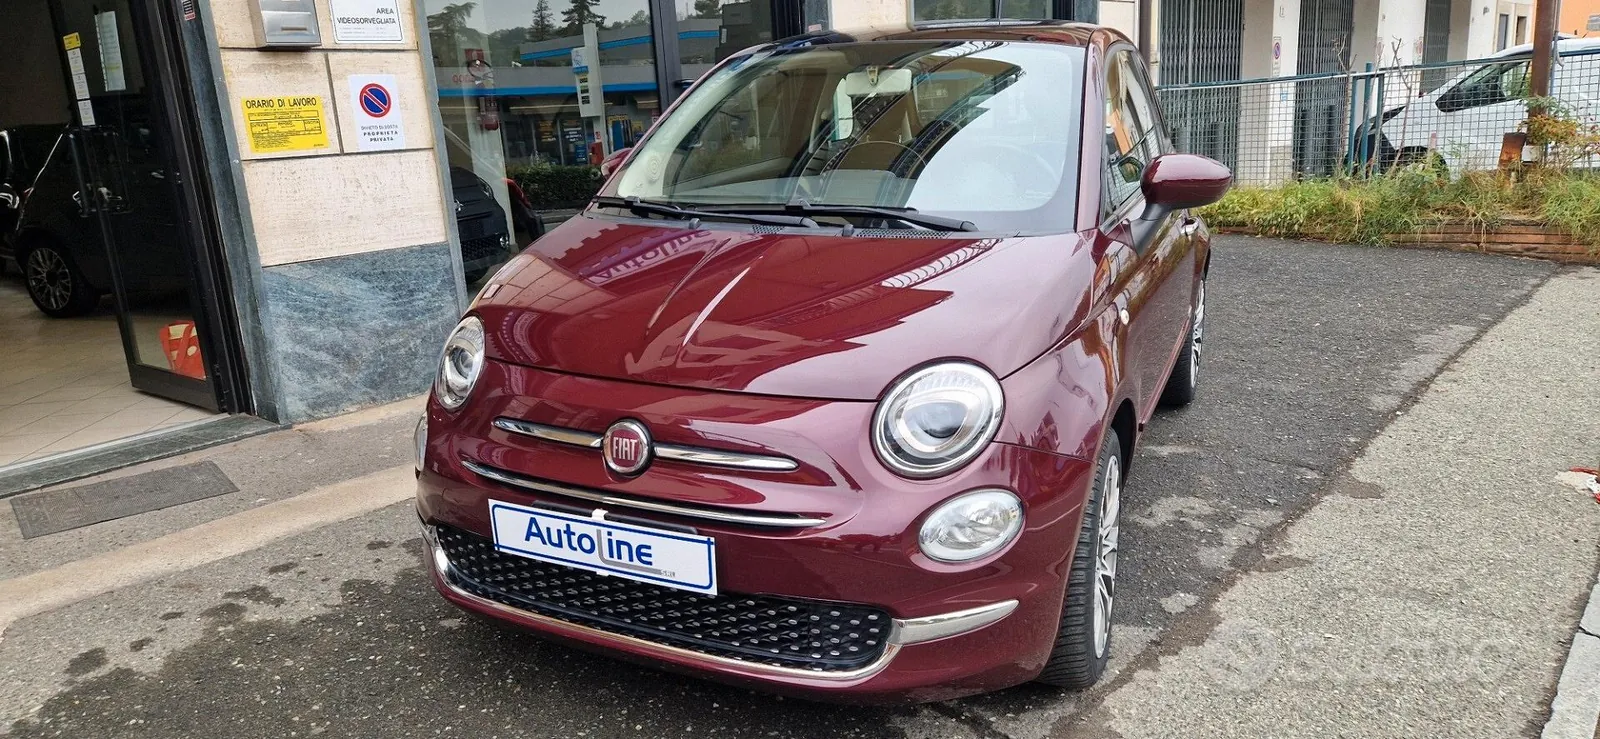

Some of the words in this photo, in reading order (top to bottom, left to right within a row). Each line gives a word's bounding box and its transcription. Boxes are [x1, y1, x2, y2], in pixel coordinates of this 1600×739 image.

[376, 7, 395, 15] AREA
[336, 16, 397, 25] VIDEOSORVEGLIATA
[245, 99, 275, 109] ORARIO
[277, 98, 286, 108] DI
[288, 97, 317, 107] LAVORO
[612, 436, 638, 461] FIAT
